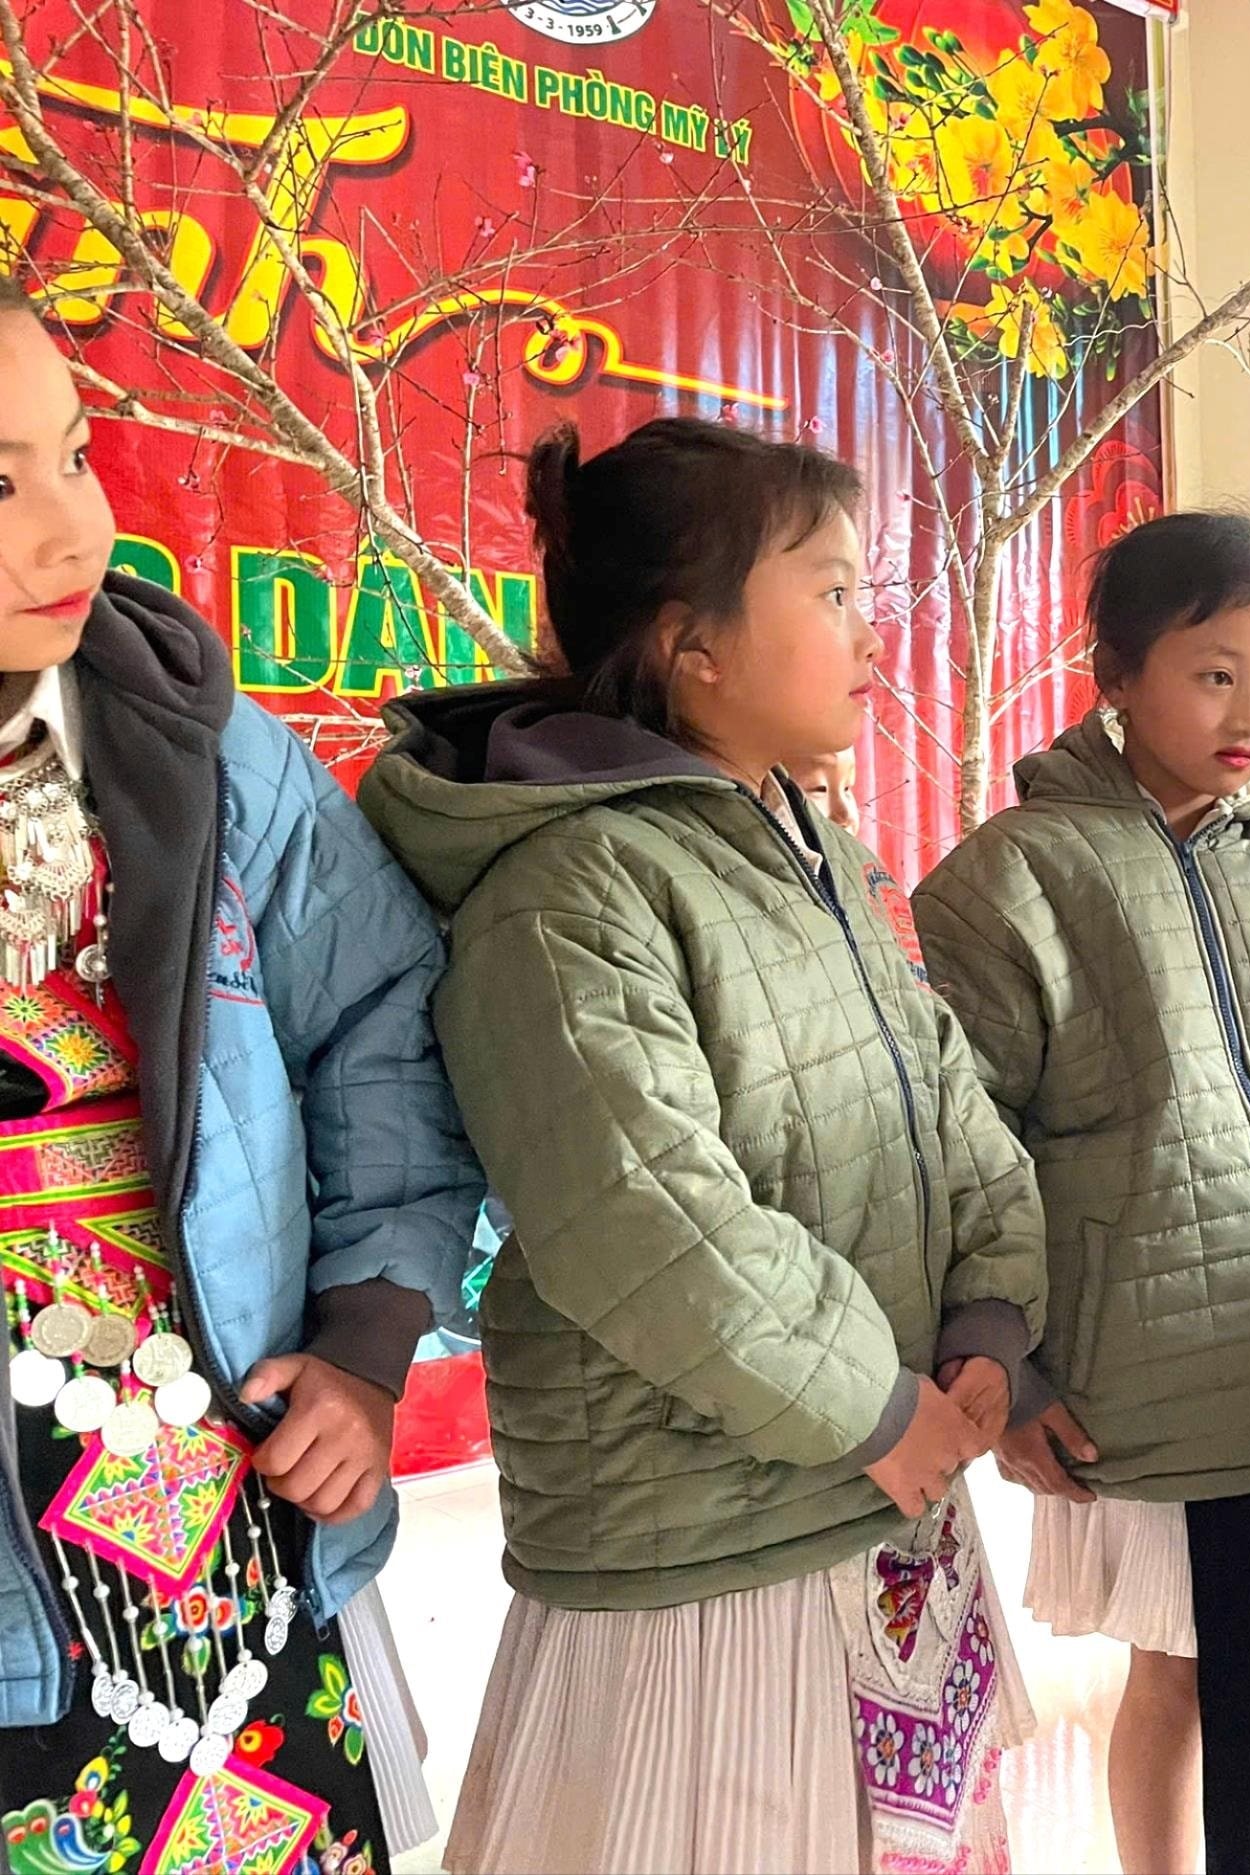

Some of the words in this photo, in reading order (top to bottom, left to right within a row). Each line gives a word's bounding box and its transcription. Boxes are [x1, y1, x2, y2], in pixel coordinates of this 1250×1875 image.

[442, 35, 528, 103] BIÊN
[534, 66, 656, 135] PHÒNG
[661, 100, 709, 152] MỸ
[714, 118, 752, 166] LÝ
[231, 532, 537, 697] DÂN
